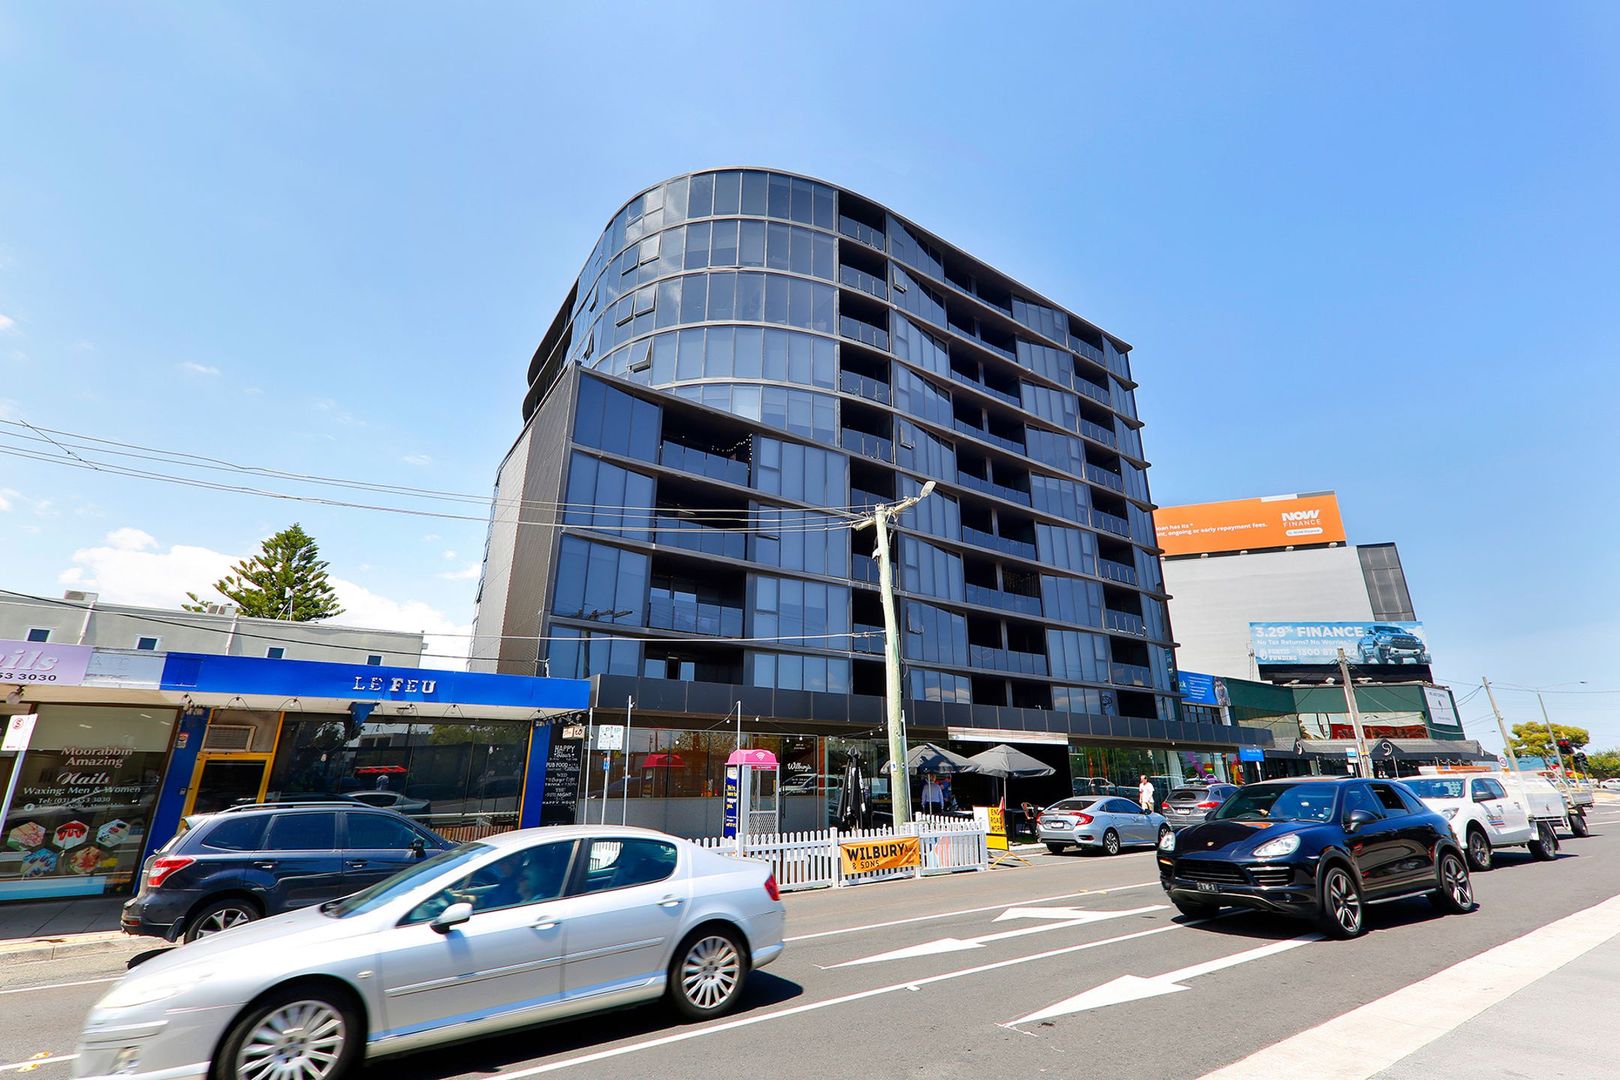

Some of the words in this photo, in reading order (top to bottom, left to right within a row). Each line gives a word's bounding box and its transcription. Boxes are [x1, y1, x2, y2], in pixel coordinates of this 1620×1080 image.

[1281, 509, 1320, 521] NOW
[1200, 526, 1216, 534] early
[1217, 523, 1252, 532] repayment
[1283, 519, 1321, 528] FINANCE
[18, 673, 57, 682] 3030
[352, 676, 383, 691] LE
[389, 677, 436, 694] FEU
[60, 746, 134, 756] Moorabbin
[65, 756, 124, 769] Amazing
[56, 771, 110, 785] Nails
[23, 786, 66, 796] Waxing:
[67, 786, 90, 794] Men
[104, 785, 141, 794] Women
[38, 796, 53, 804] Tel:
[846, 843, 906, 862] WILBURY
[860, 860, 880, 870] SONS
